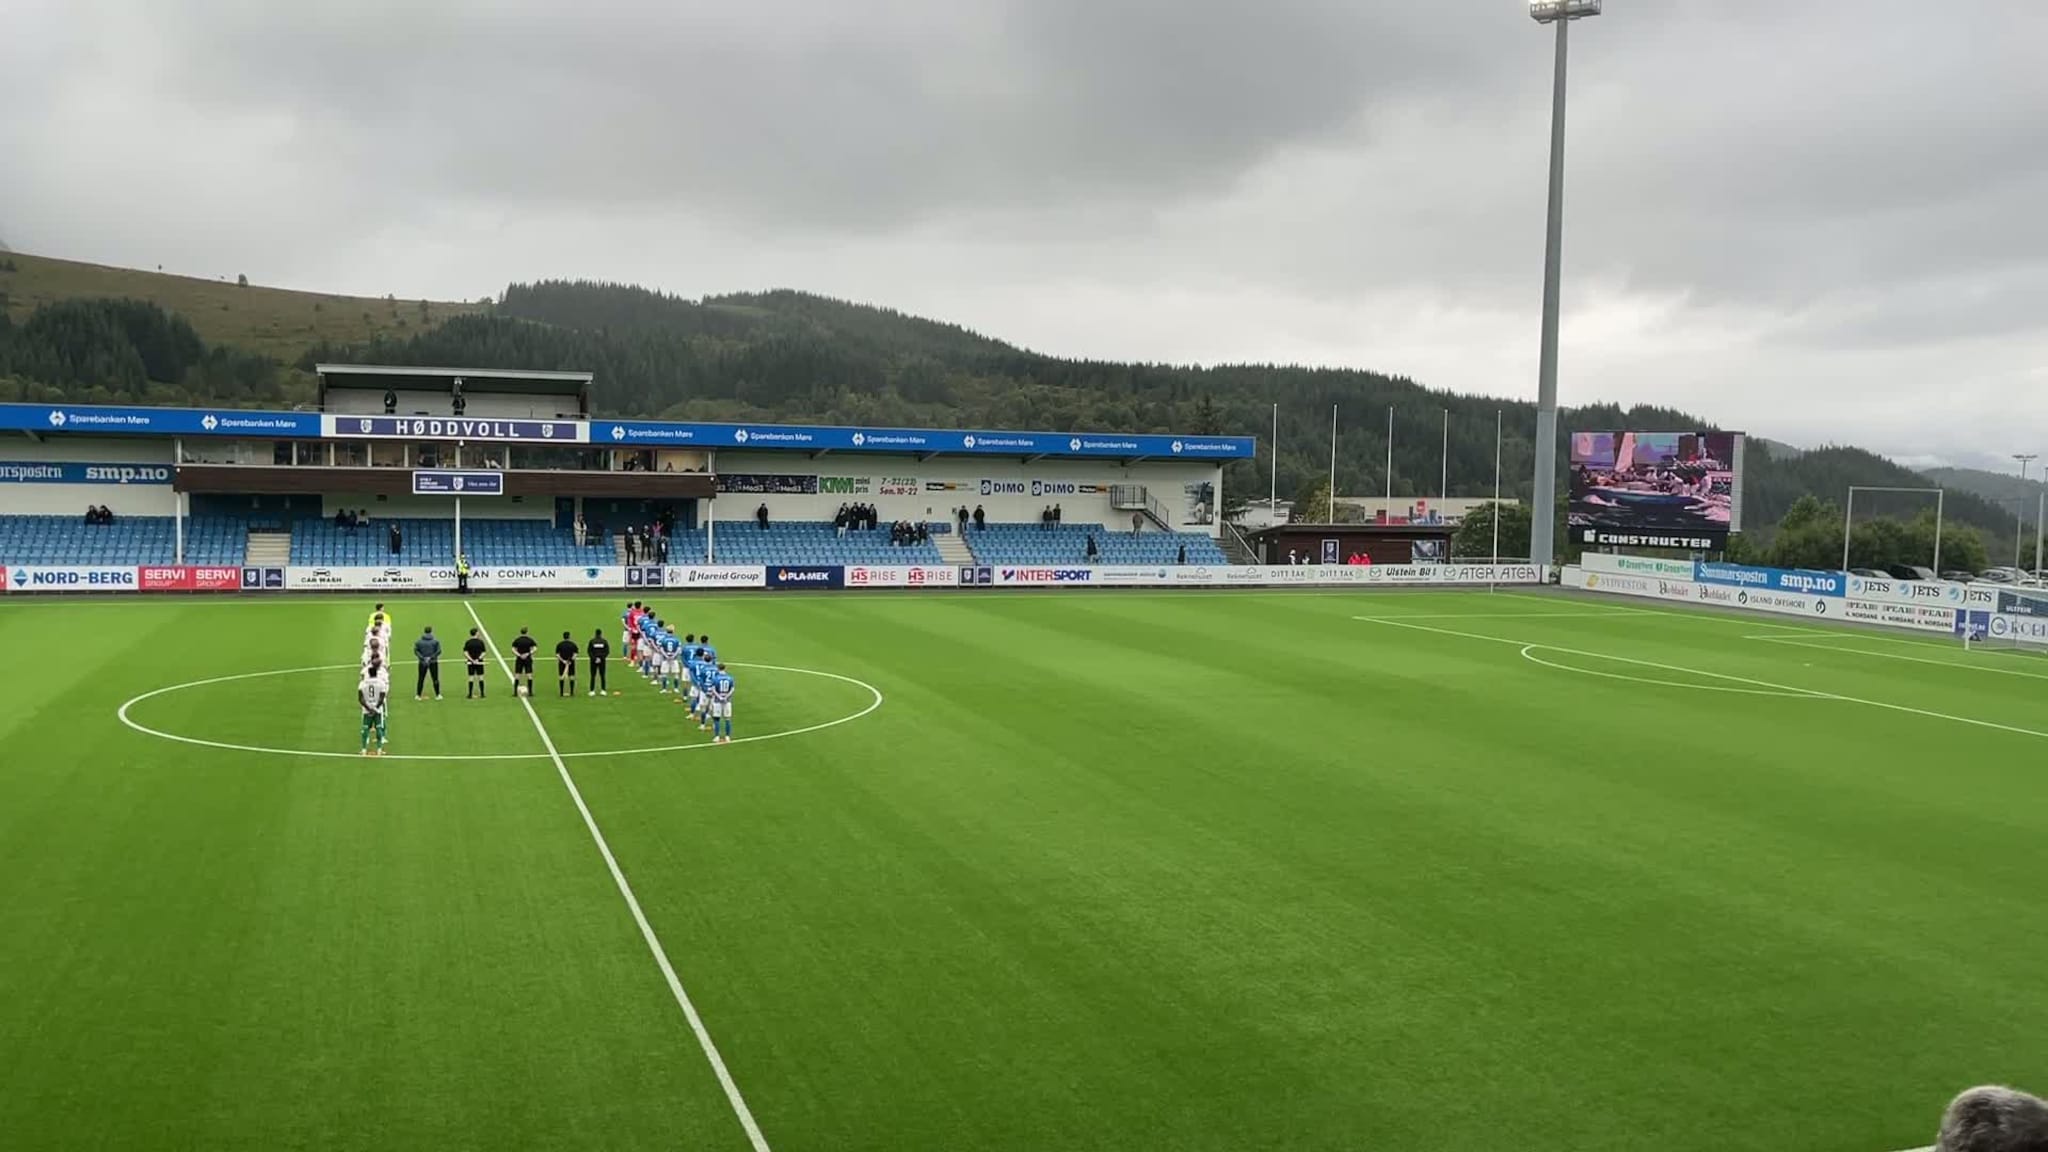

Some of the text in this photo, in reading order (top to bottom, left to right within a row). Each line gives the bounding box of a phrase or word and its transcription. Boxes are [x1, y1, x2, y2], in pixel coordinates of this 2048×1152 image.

[396, 420, 519, 437] HØDDVOLL
[86, 466, 168, 483] smp.no
[819, 477, 854, 494] KIWI
[856, 477, 870, 485] mini
[856, 486, 868, 494] pris
[994, 483, 1024, 493] DIMO
[1044, 483, 1075, 493] DIMO
[1600, 534, 1711, 548] CONSTRUCTER
[33, 571, 133, 584] NORD-BERG
[145, 569, 185, 579] SERVI
[196, 569, 236, 579] SERVI
[430, 570, 489, 579] CONLAN
[498, 570, 556, 578] CONPLAN
[697, 571, 758, 582] Hareid Group
[871, 571, 896, 580] RISE
[928, 571, 952, 580] RISE
[1017, 570, 1091, 581] INTERSPORT
[1386, 568, 1416, 576] Ulstein
[1501, 567, 1536, 579] ATEA
[1780, 573, 1836, 592] smp.no
[1863, 578, 1890, 594] JETS
[1912, 582, 1940, 598] JETS
[1961, 587, 1992, 603] JETS
[1751, 596, 1806, 609] ISLAND OFFSHORE
[369, 685, 374, 698] 9
[720, 680, 730, 692] 10
